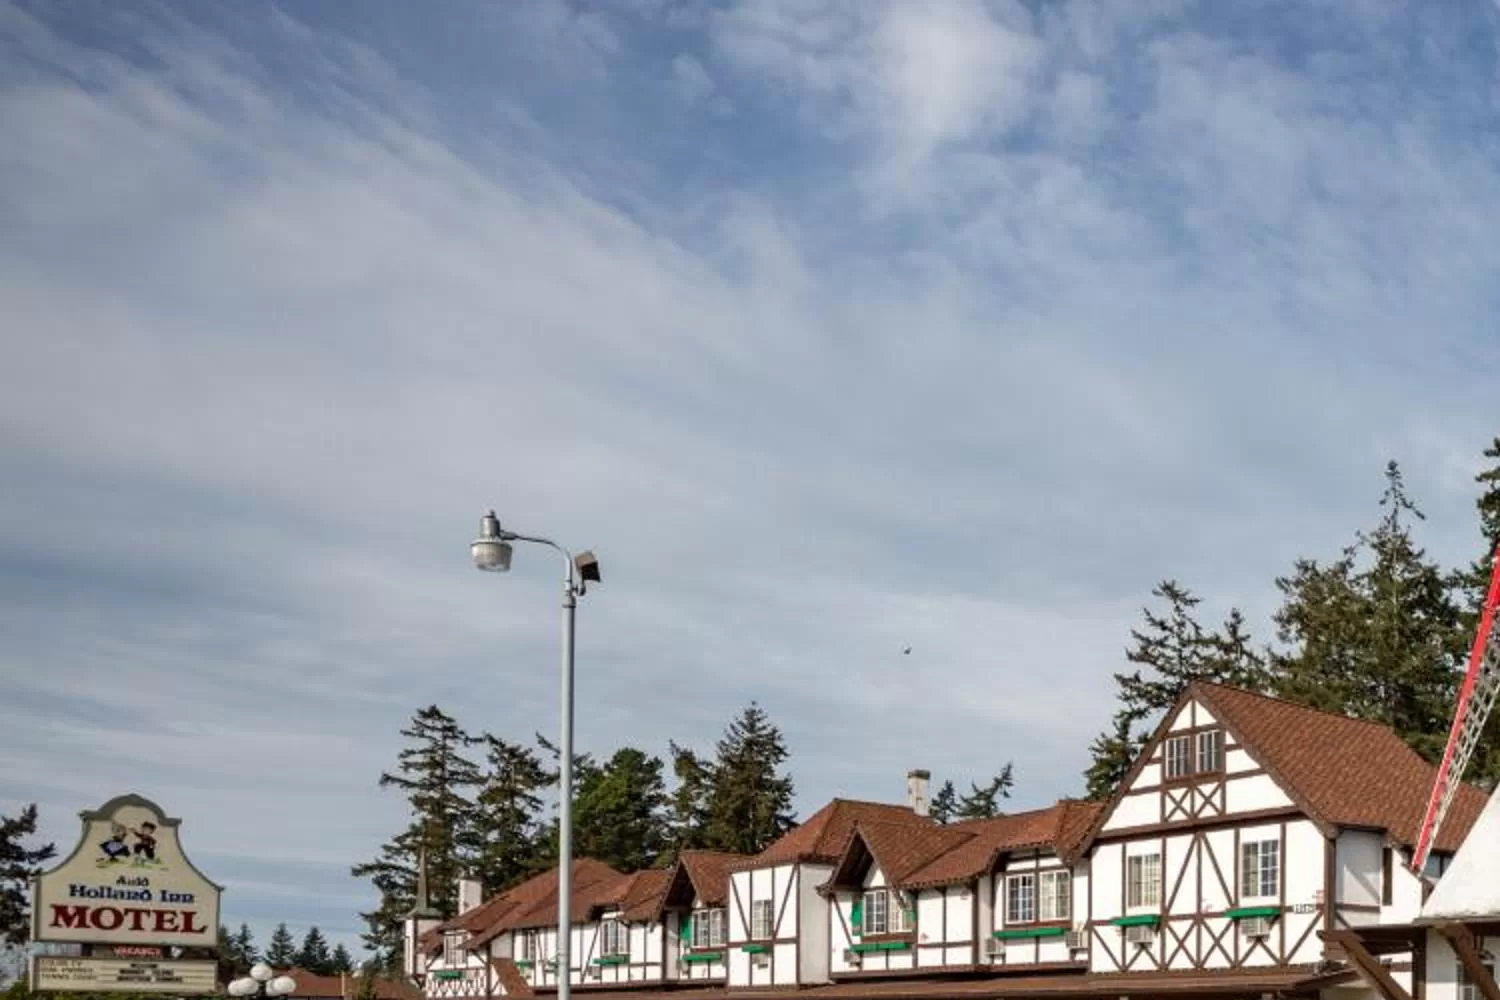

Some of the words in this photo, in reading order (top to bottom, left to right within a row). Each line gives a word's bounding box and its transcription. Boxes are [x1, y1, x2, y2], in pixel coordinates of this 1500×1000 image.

[68, 883, 152, 901] Holland
[160, 889, 195, 903] Inn
[49, 903, 209, 934] MOTEL
